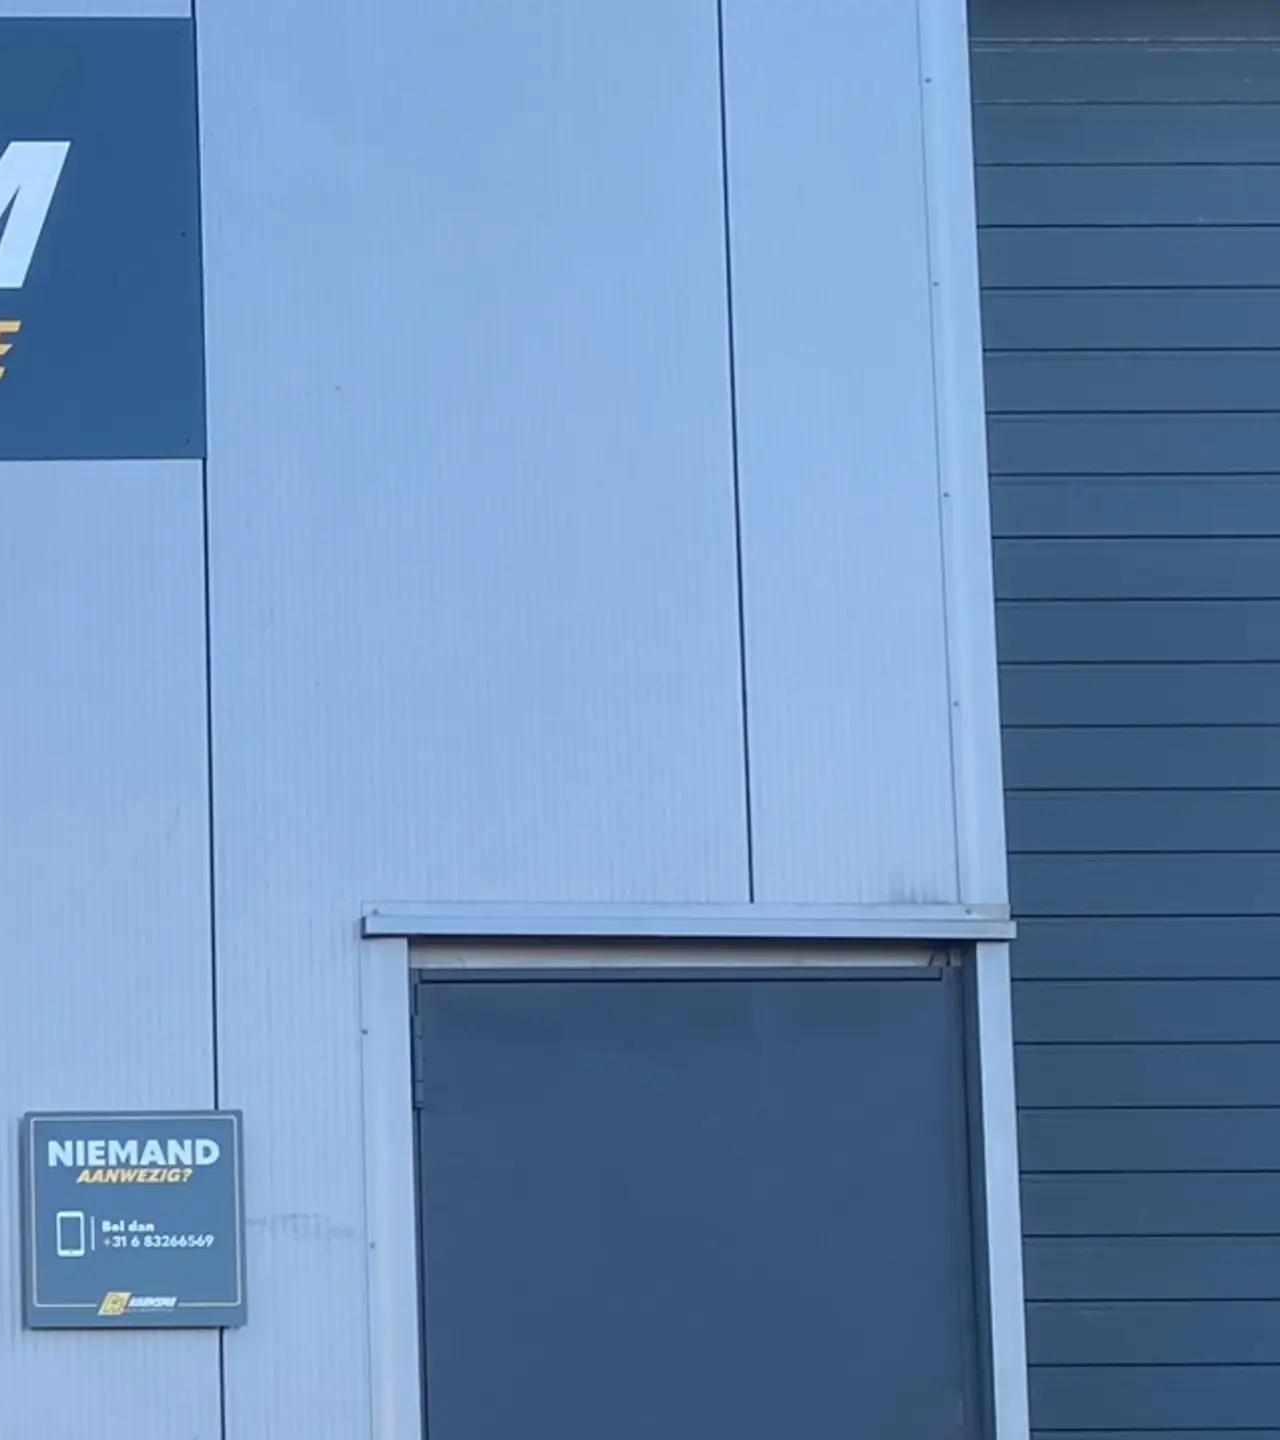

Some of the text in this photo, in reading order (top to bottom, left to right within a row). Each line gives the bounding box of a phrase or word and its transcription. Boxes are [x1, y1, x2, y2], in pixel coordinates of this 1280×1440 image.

[47, 1139, 221, 1167] NIEMAND
[76, 1168, 194, 1184] AANWEZIG?
[127, 1219, 155, 1232] dan
[103, 1235, 128, 1248] +31
[130, 1235, 141, 1248] 6
